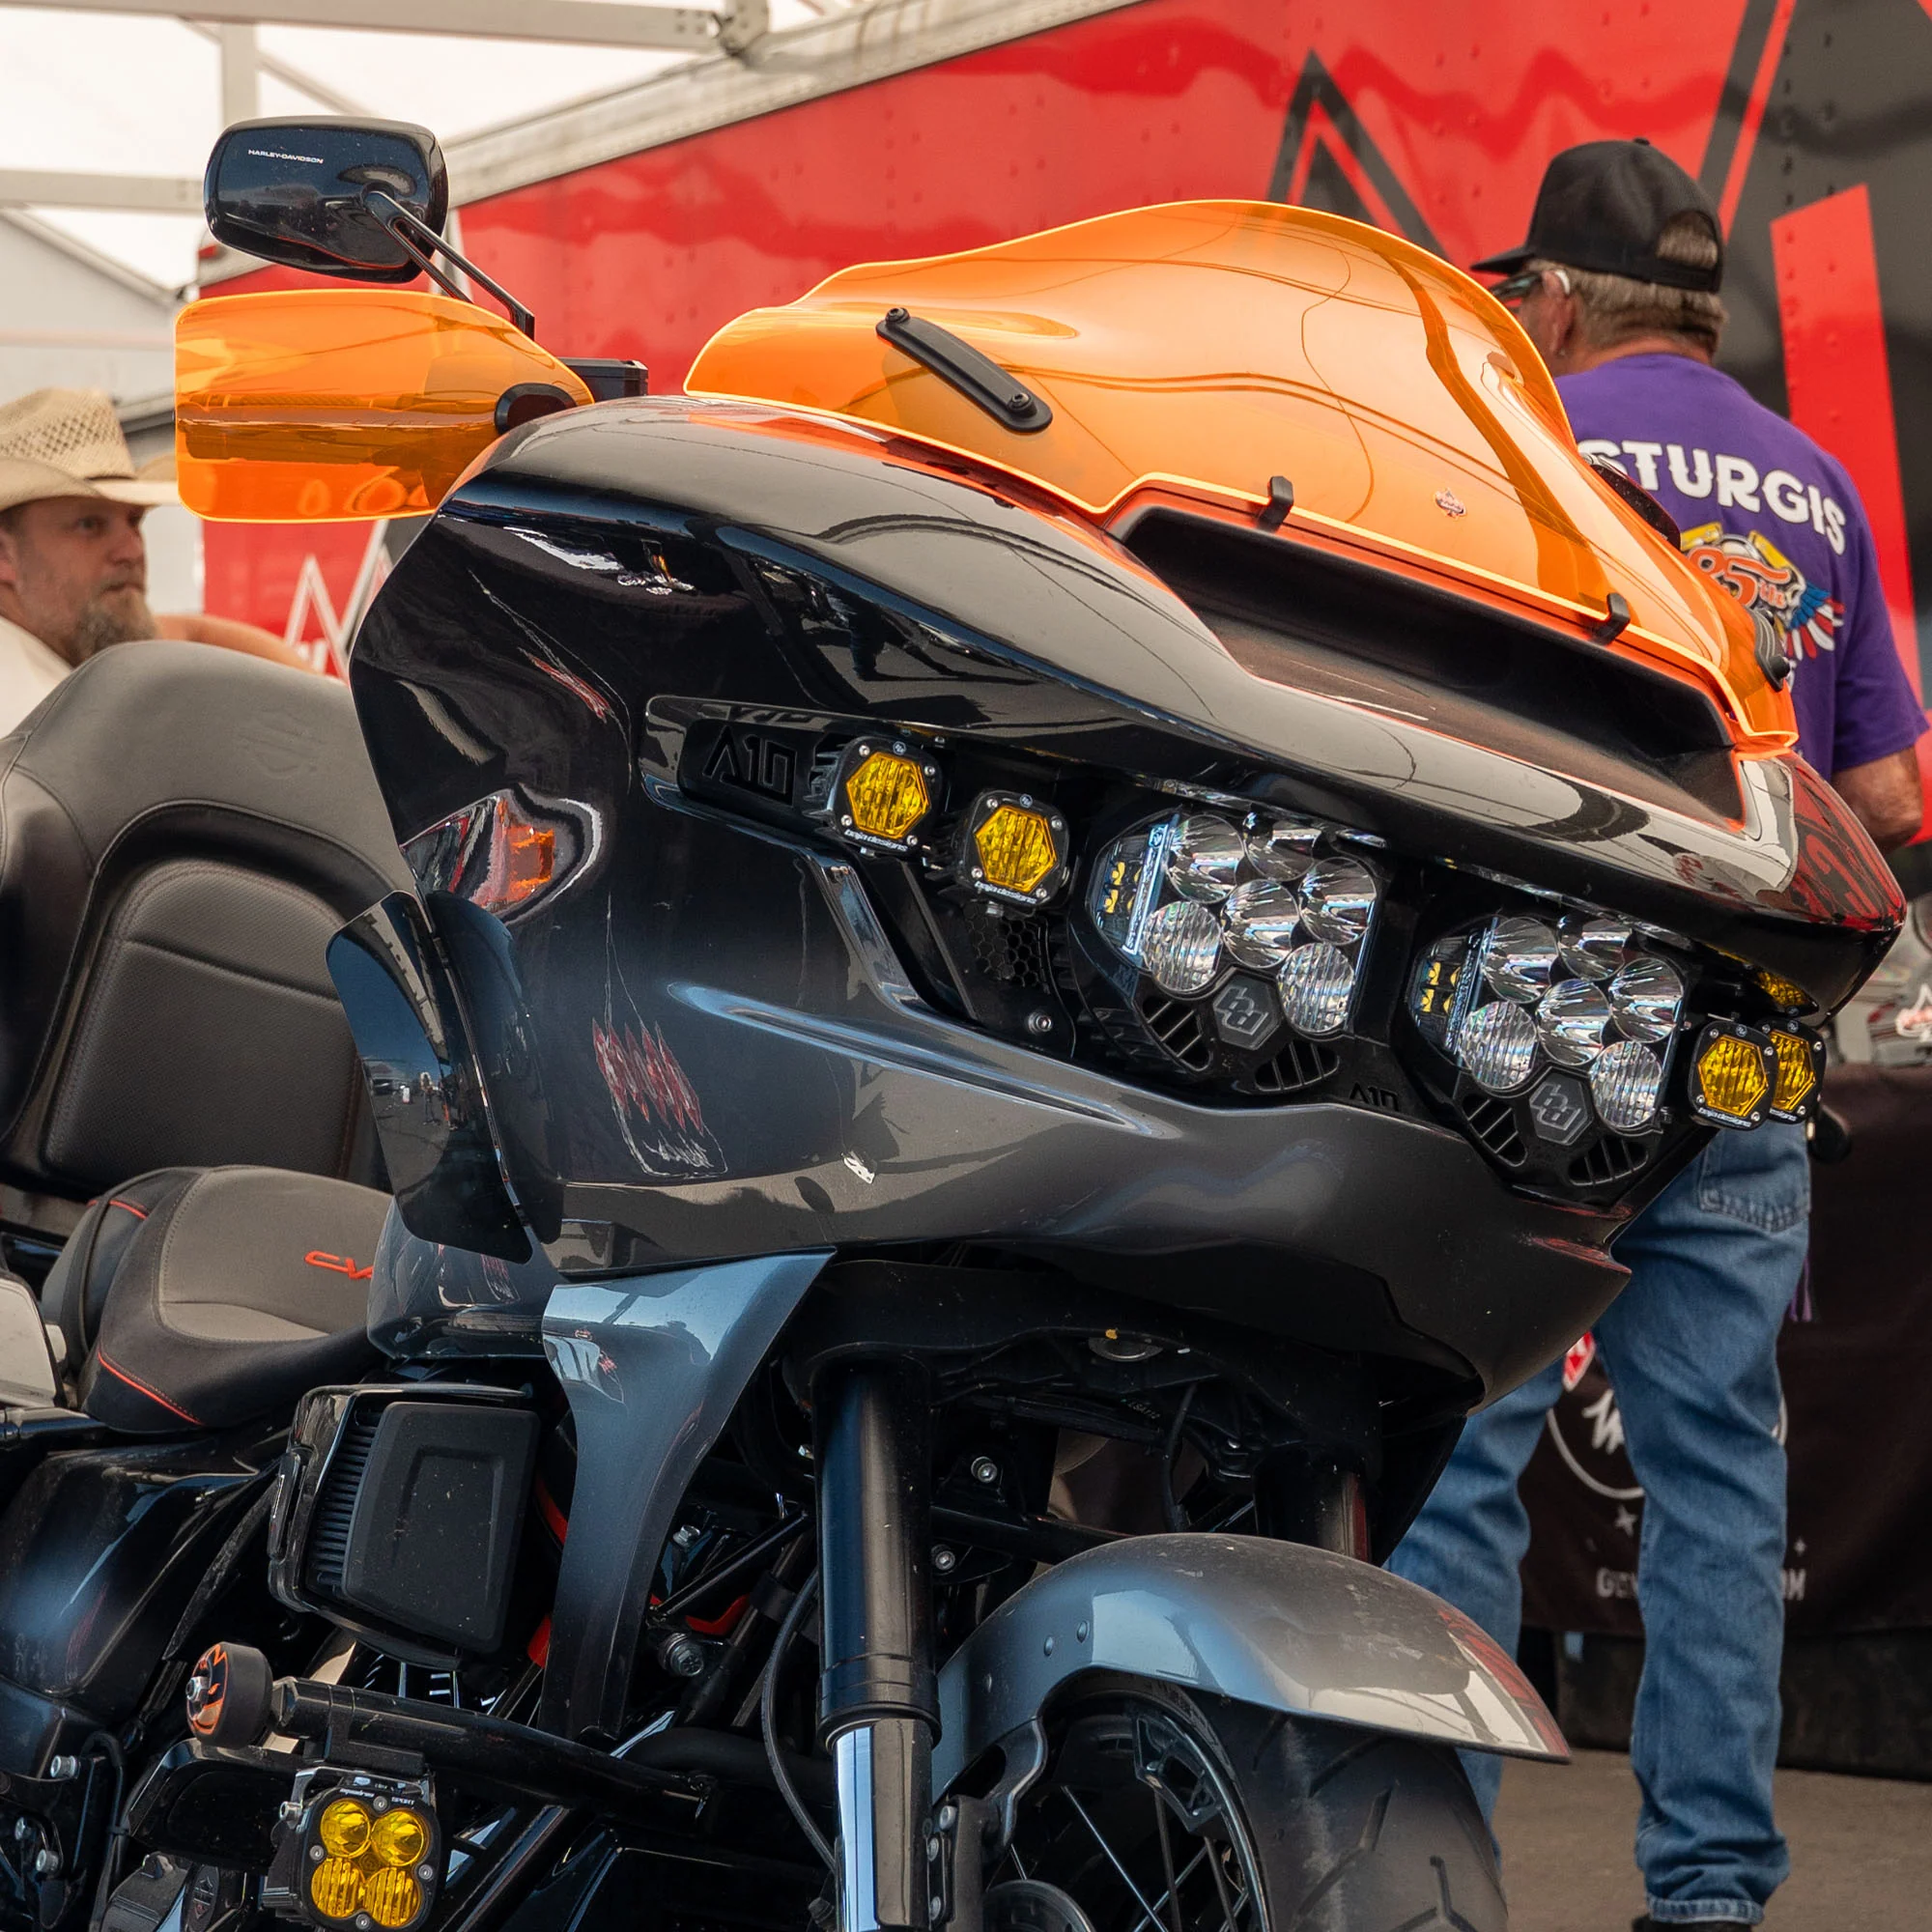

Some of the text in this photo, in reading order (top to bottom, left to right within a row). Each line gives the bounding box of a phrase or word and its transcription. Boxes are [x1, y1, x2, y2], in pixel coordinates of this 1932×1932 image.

[247, 149, 325, 164] HARLEY-DAVIDSON
[1577, 439, 1846, 555] STURGIS
[304, 1250, 375, 1280] CV
